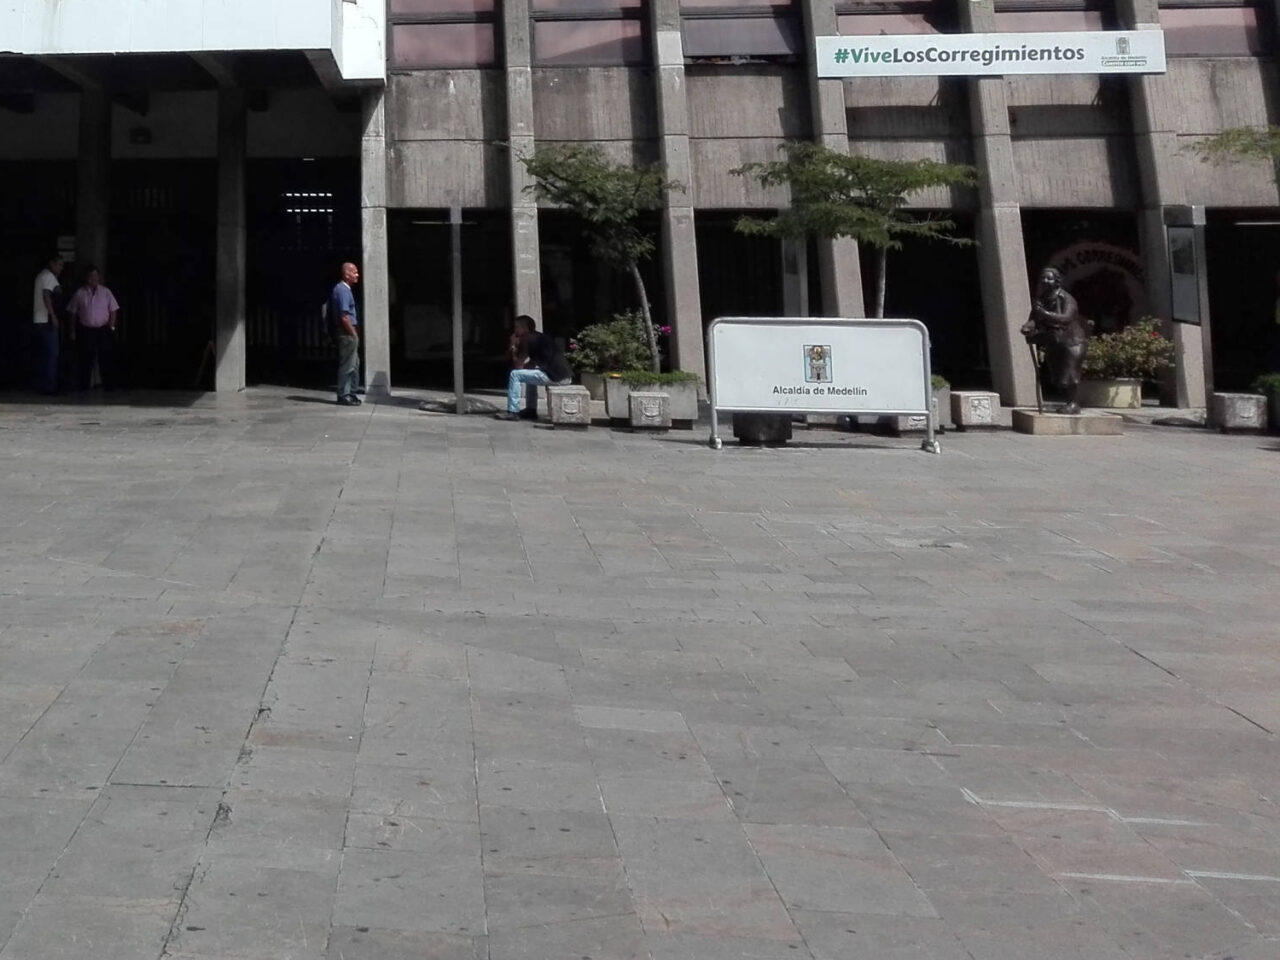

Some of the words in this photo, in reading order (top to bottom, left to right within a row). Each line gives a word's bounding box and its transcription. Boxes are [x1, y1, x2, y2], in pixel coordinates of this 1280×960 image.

[833, 44, 1086, 66] #ViveLosCorregimientos
[772, 385, 810, 395] Alcaldía
[813, 386, 825, 395] de
